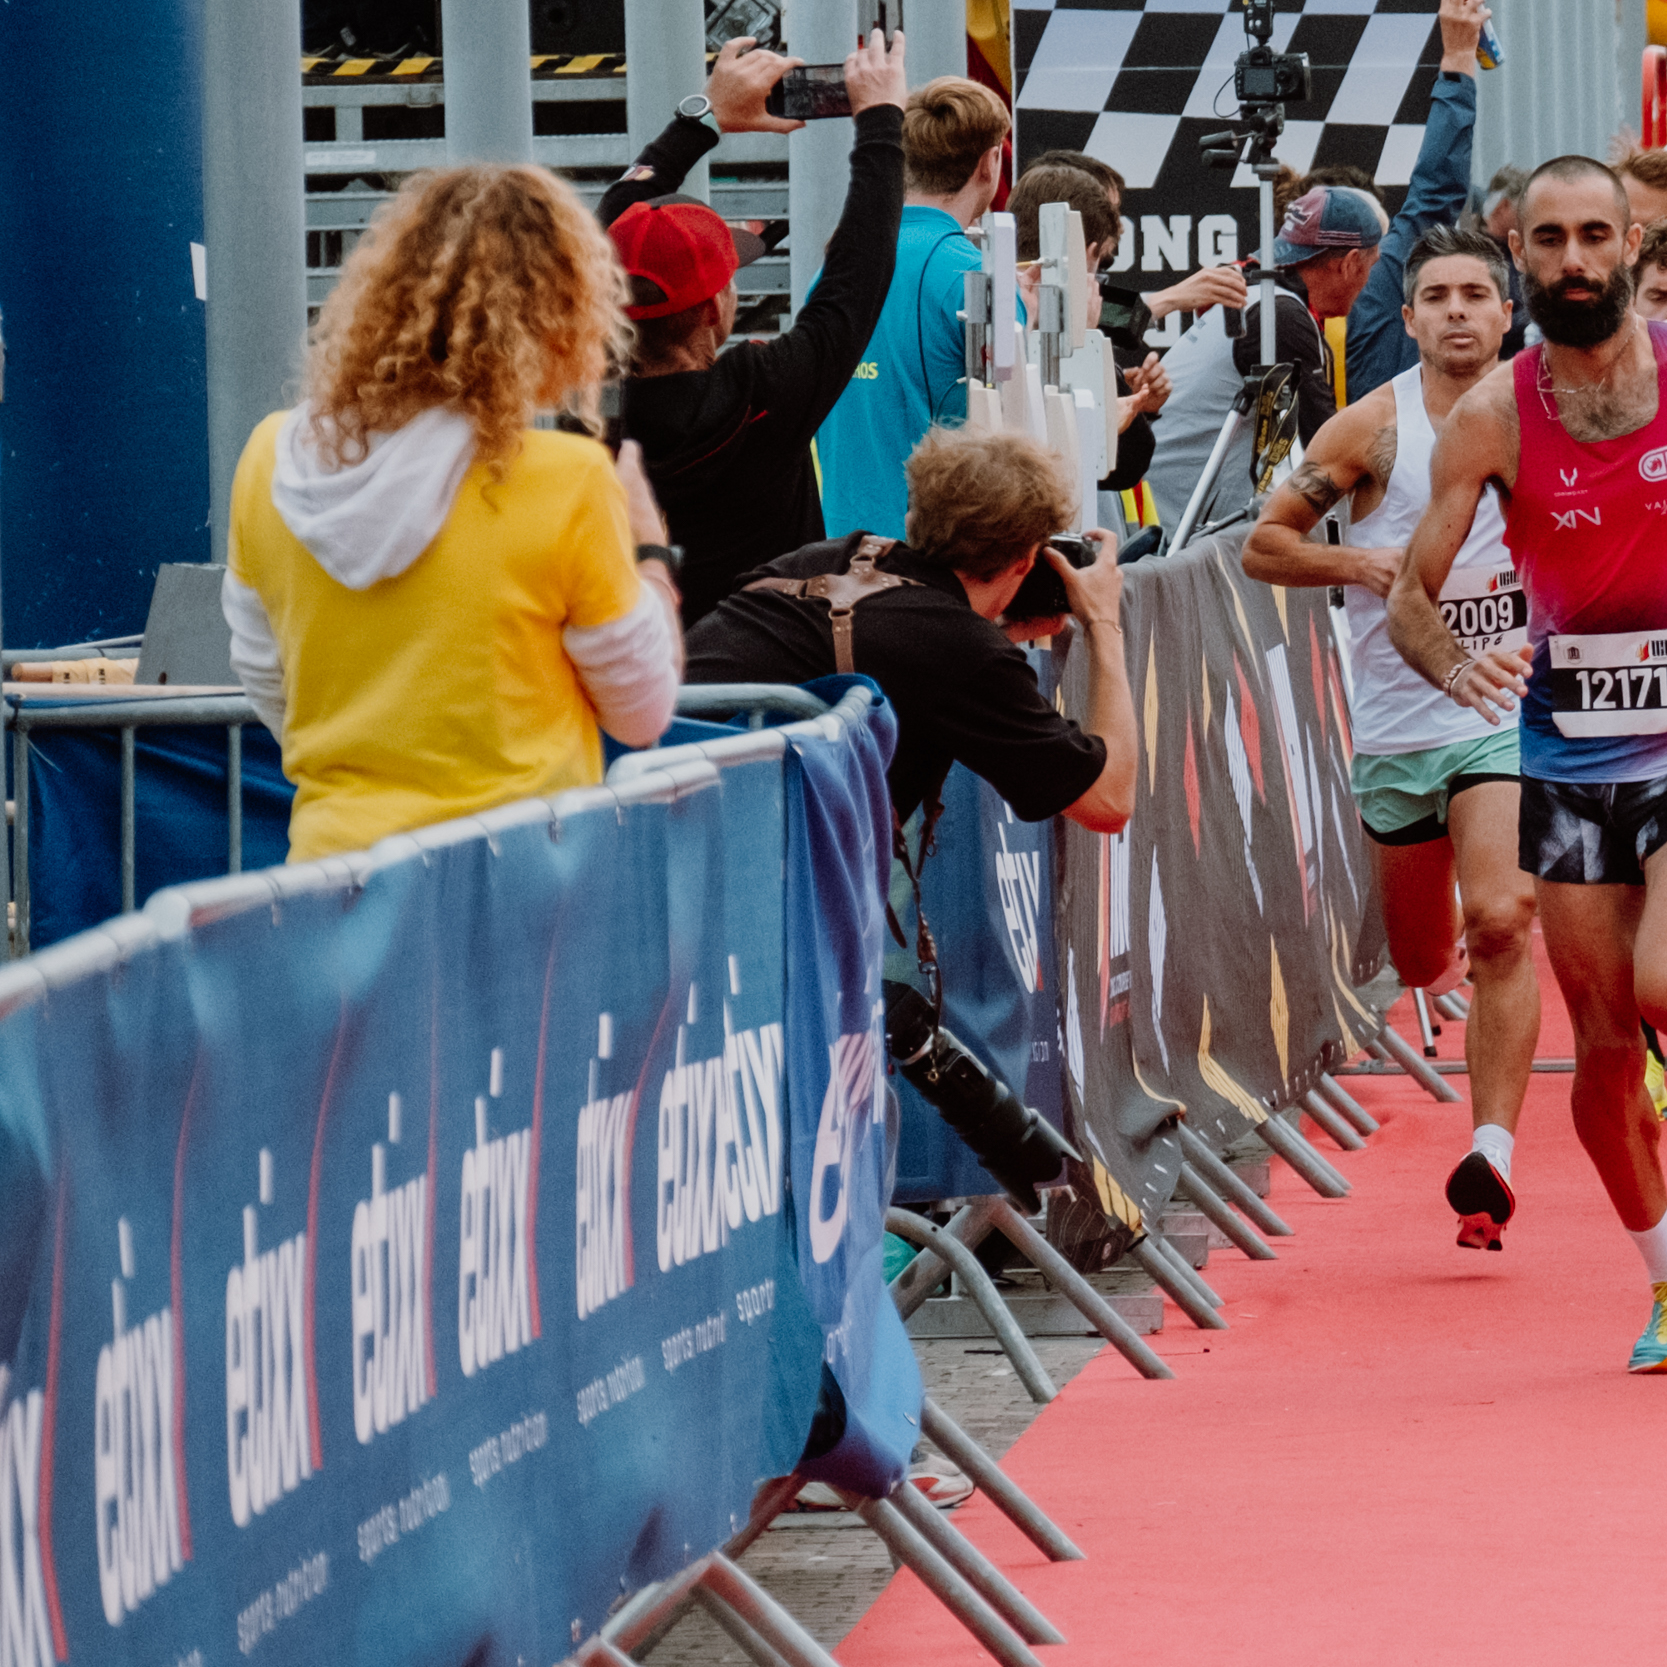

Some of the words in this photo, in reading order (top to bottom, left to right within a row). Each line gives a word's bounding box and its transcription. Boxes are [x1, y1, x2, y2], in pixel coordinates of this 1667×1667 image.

[1108, 213, 1238, 272] ONG
[1440, 594, 1514, 638] 2009
[1460, 634, 1505, 653] LIPE
